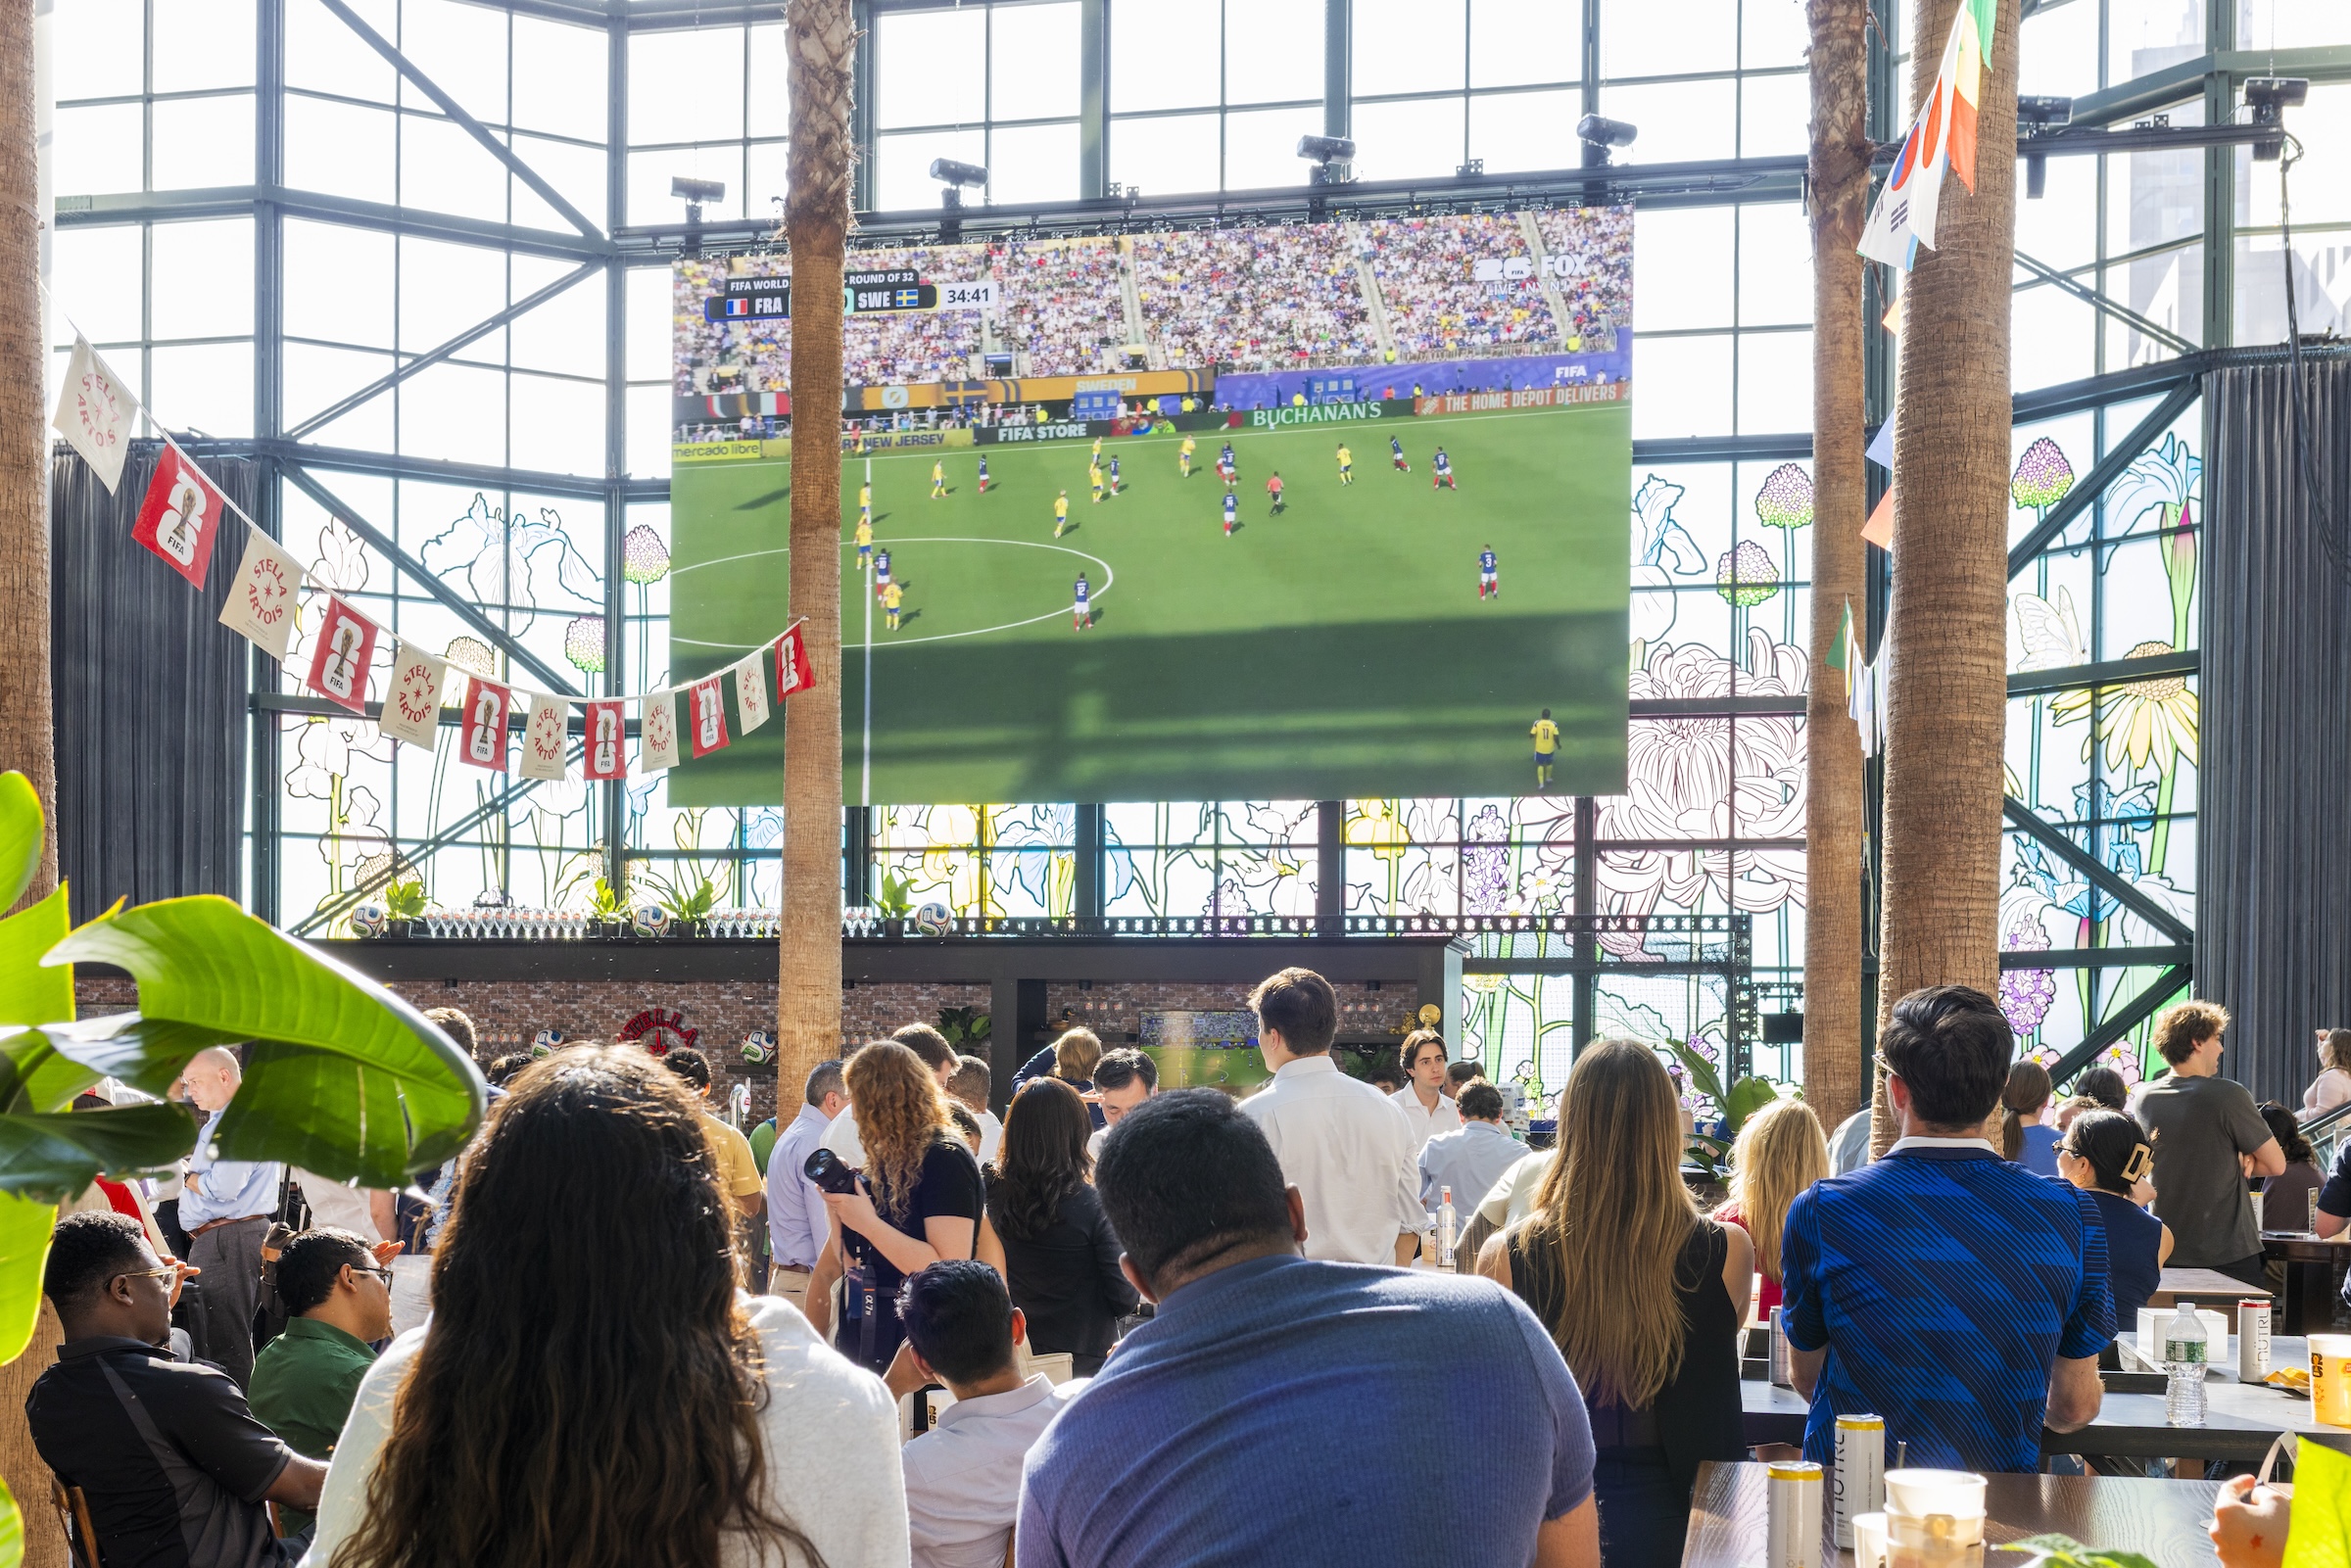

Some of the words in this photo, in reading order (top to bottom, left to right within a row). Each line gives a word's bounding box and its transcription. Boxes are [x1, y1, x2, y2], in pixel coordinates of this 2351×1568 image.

[1541, 254, 1590, 278] FOX
[731, 280, 752, 292] FIFA
[753, 279, 790, 291] WORLD
[849, 274, 885, 285] ROUND
[887, 273, 900, 283] OF
[901, 272, 914, 282] 32
[947, 288, 989, 304] 34:41
[1486, 283, 1516, 296] LIVE
[1526, 282, 1546, 294] NY
[1550, 281, 1569, 293] NJ
[755, 297, 783, 314] FRA
[858, 292, 890, 309] SWE
[1555, 365, 1587, 378] FIFA
[1076, 377, 1136, 392] SWEDEN
[81, 373, 120, 423] STELLA
[1446, 394, 1468, 412] THE
[1471, 392, 1509, 410] HOME
[1511, 389, 1553, 407] DEPOT
[1556, 385, 1616, 404] DELIVERS
[77, 393, 117, 448] ARTOIS
[1253, 402, 1382, 426] BUCHANAN'S
[1036, 423, 1087, 439] STORE
[673, 445, 728, 457] mercado
[731, 442, 759, 456] libre
[863, 437, 892, 449] NEW
[895, 433, 945, 447] JERSEY
[168, 535, 184, 555] FIFA
[254, 558, 288, 598] STELLA
[1077, 586, 1085, 596] 12
[248, 583, 283, 625] ARTOIS
[329, 676, 344, 690] FIFA
[404, 664, 435, 696] STELLA
[744, 667, 761, 691] STELLA
[399, 691, 432, 723] ARTOIS
[648, 703, 671, 728] STELLA
[536, 708, 562, 734] STELLA
[648, 729, 672, 753] ARTOIS
[705, 734, 715, 742] FIFA
[1542, 728, 1550, 740] 11
[476, 745, 489, 755] FIFA
[534, 736, 561, 761] ARTOIS
